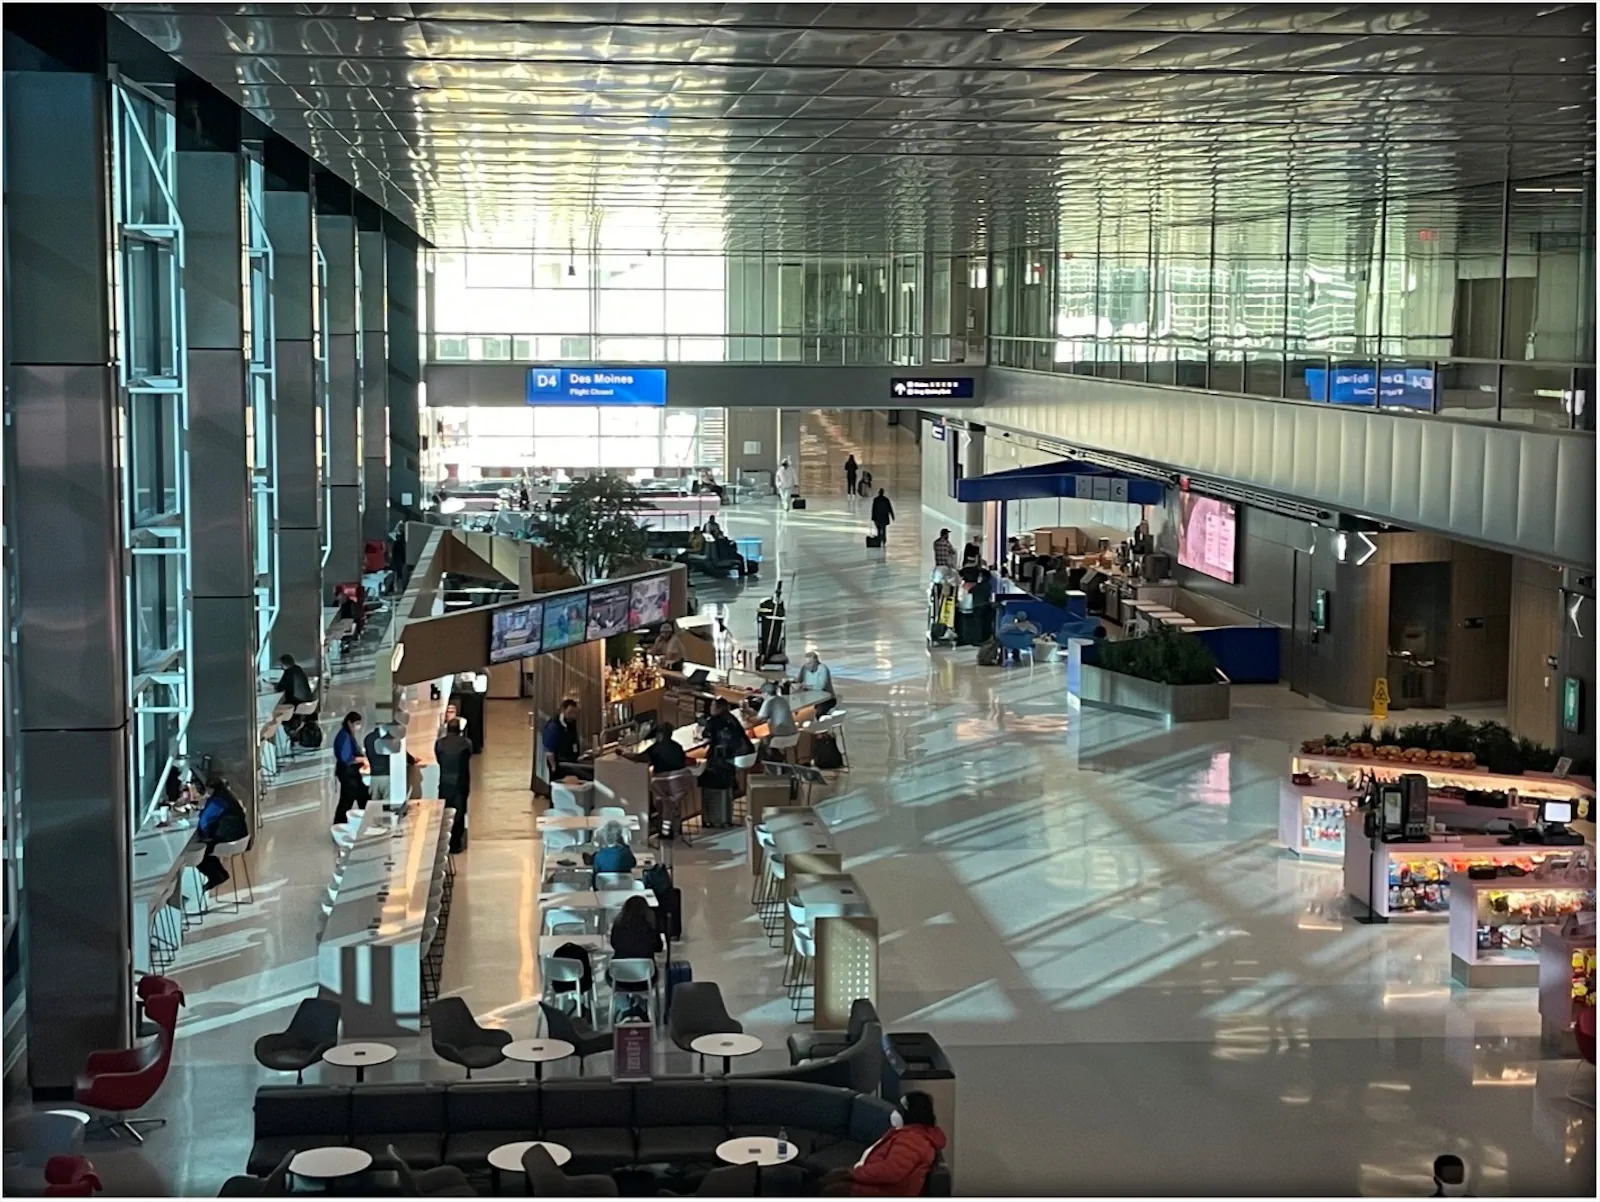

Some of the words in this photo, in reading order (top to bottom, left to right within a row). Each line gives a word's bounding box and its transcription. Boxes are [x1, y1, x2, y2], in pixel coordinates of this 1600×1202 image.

[537, 374, 557, 387] D4
[569, 373, 591, 384] Des
[594, 373, 634, 384] Moines
[569, 388, 590, 396] Flight
